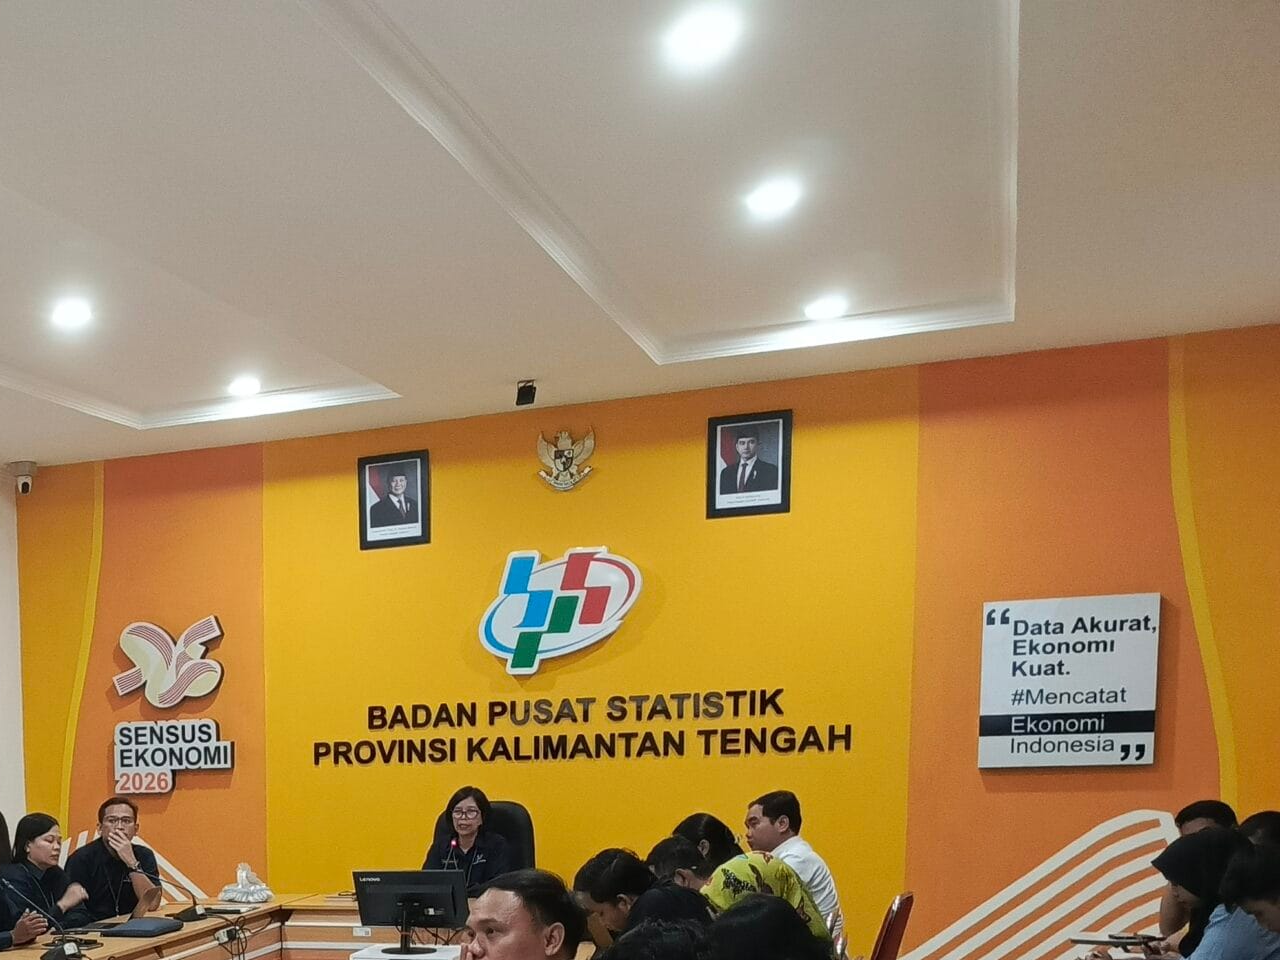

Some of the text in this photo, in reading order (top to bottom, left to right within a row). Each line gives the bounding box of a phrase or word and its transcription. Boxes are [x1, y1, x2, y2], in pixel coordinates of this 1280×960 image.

[1013, 615, 1157, 636] Data Akurat,
[1013, 639, 1115, 655] Ekonomi
[1012, 660, 1070, 677] Kuat.
[1011, 687, 1127, 706] #Mencatat
[368, 689, 784, 729] BADAN PUSAT STATISTIK
[1011, 714, 1105, 733] Ekonomi
[119, 724, 212, 745] SENSUS
[314, 724, 851, 765] PROVINSI KALIMANTAN TENGAH
[1011, 736, 1114, 753] Indonesia
[120, 746, 228, 767] EKONOMI
[120, 772, 168, 790] 2026
